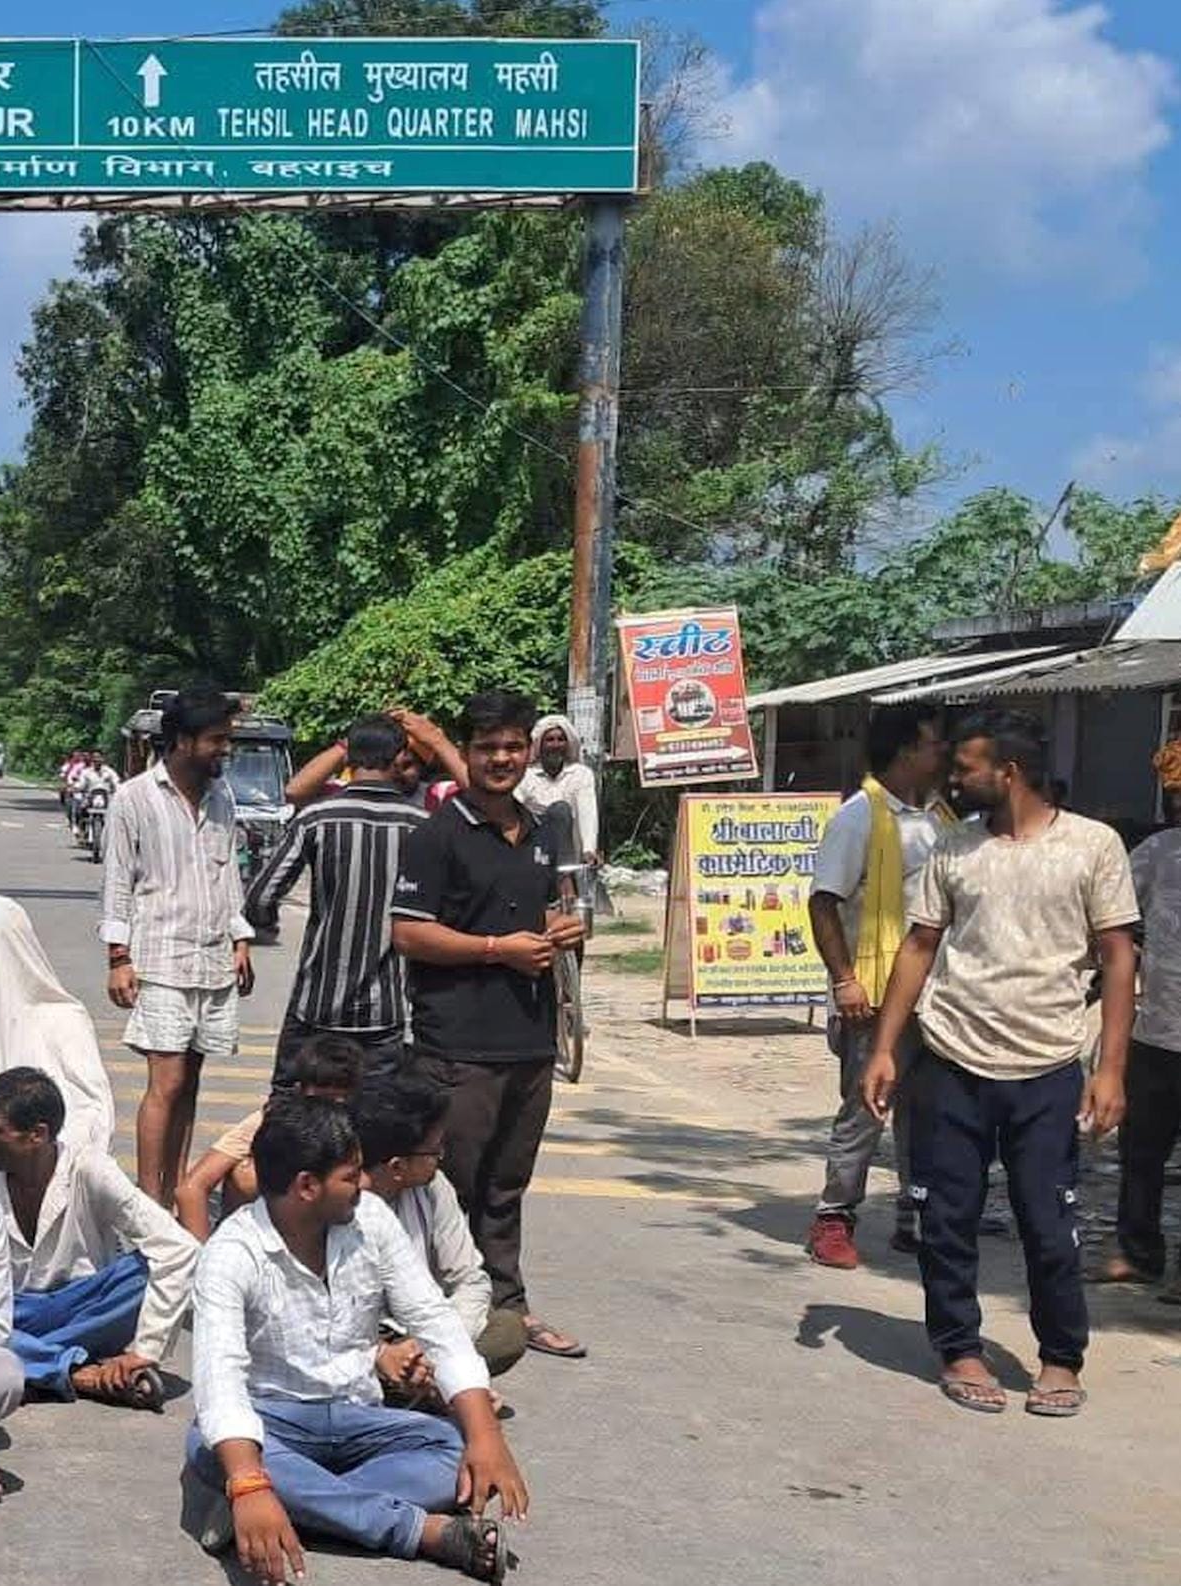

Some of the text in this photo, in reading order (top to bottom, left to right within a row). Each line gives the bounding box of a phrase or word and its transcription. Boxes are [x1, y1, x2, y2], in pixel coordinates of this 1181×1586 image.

[254, 51, 559, 103] तहसील मुख्यालय महसी
[219, 107, 293, 138] TEHSIL
[308, 108, 369, 138] HEAD
[387, 107, 494, 139] QUARTER
[516, 108, 587, 138] MAHSI
[249, 159, 394, 178] बहराइच
[793, 844, 819, 874] शॉ
